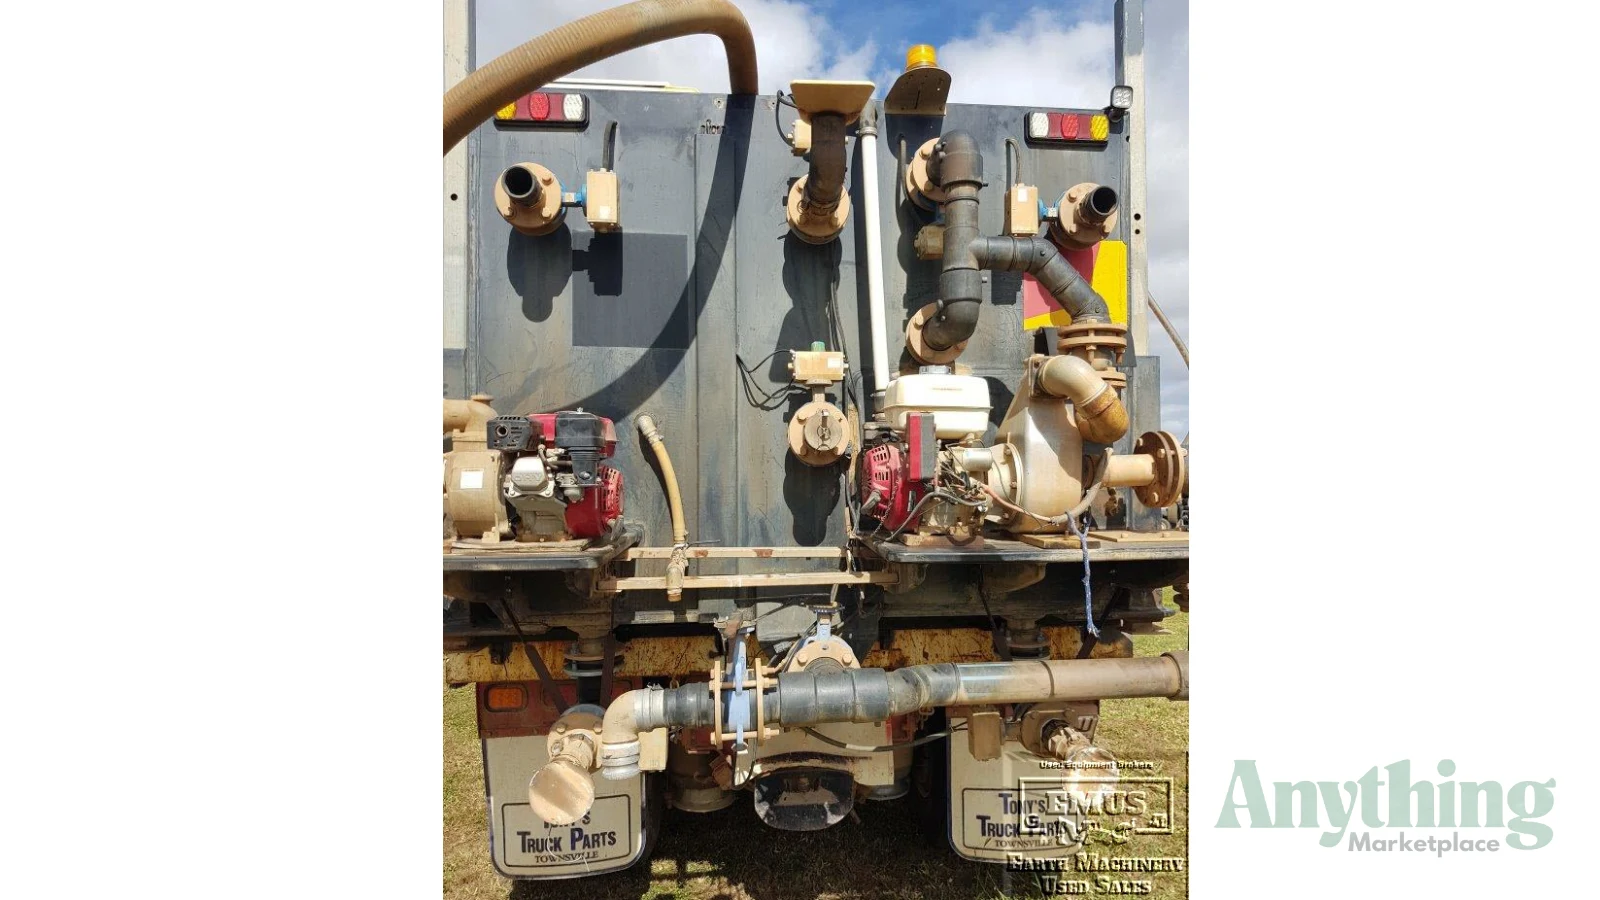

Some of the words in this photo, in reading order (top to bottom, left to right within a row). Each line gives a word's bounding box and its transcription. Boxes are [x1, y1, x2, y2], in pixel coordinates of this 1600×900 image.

[976, 815, 1020, 838] TRUCK
[517, 830, 562, 853] TRUCK
[570, 827, 617, 850] PARTS
[995, 839, 1054, 848] TOWNSVILLE
[535, 851, 599, 864] TOWNSVILLE
